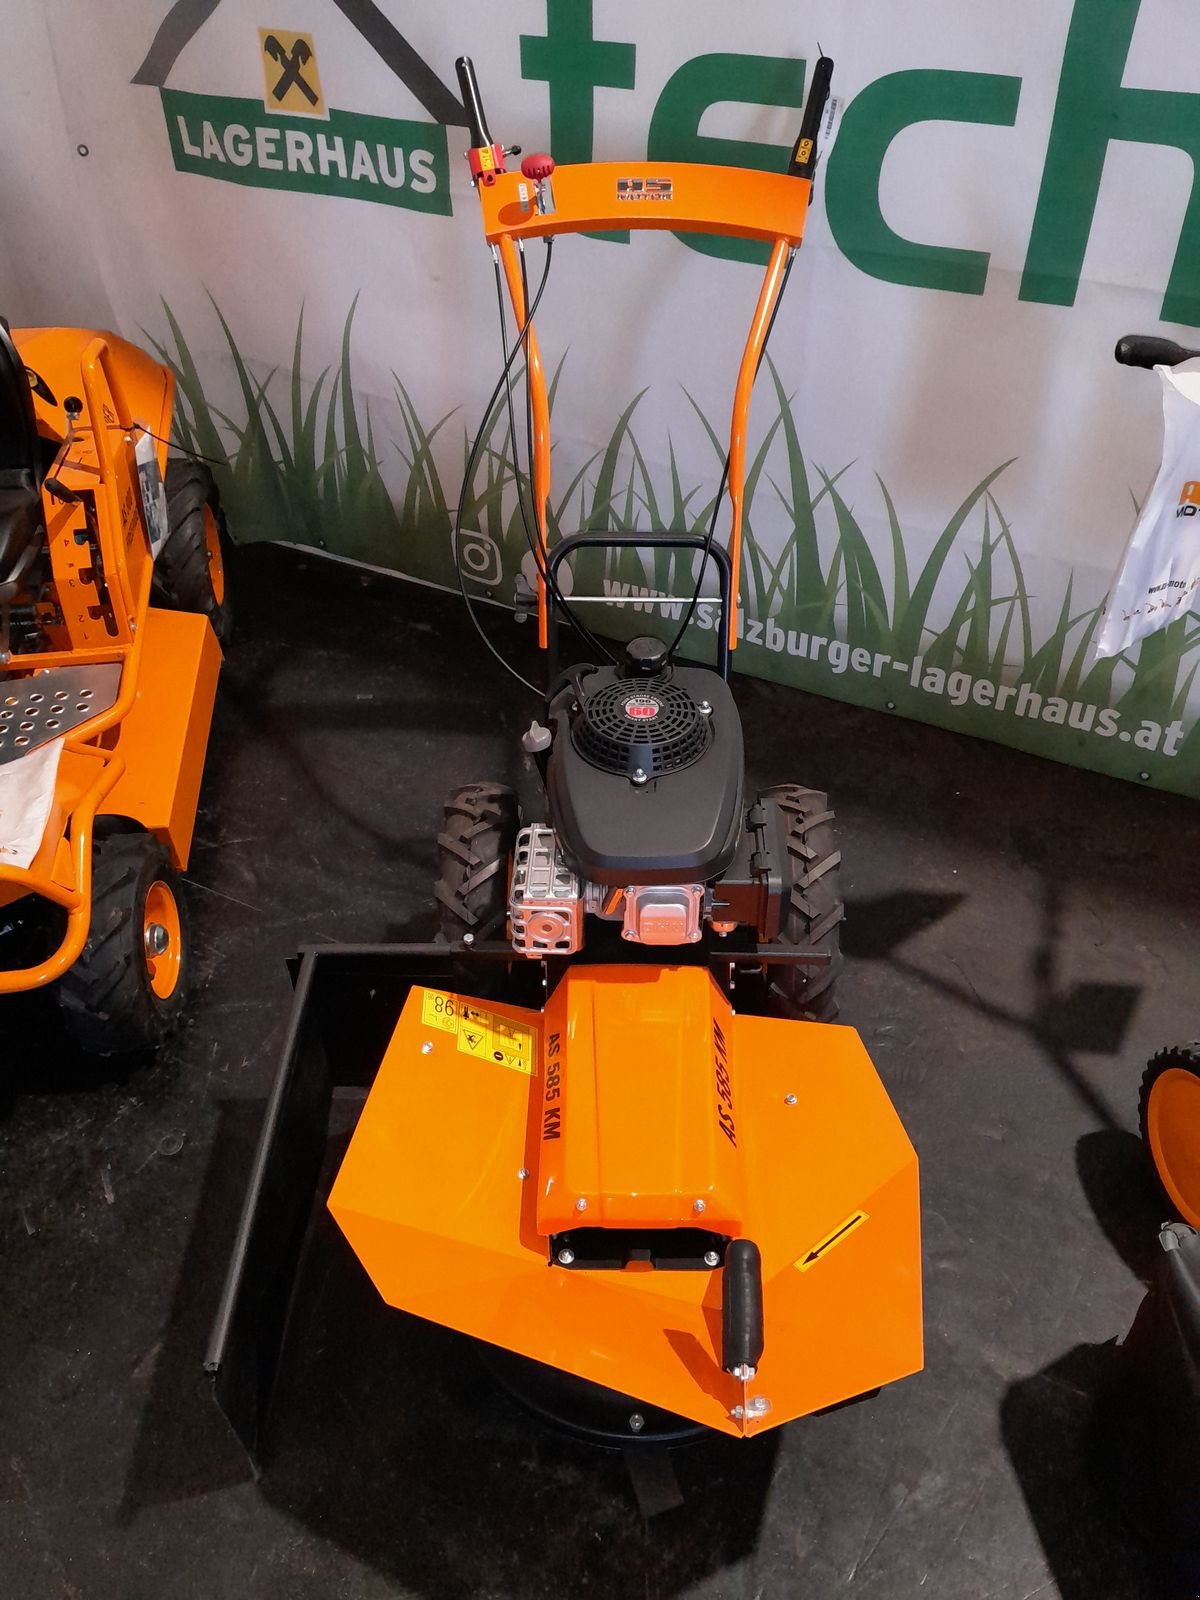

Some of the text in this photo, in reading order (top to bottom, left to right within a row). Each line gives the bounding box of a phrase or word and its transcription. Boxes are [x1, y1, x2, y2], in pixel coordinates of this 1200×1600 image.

[176, 114, 437, 194] LAGERHAUS
[1176, 505, 1200, 518] MO
[602, 578, 1185, 757] www.slzburger-lagerhaus.at
[629, 707, 655, 716] 60
[543, 1032, 561, 1140] AS 585 KM
[715, 1056, 733, 1109] 585
[718, 1103, 737, 1148] AS
